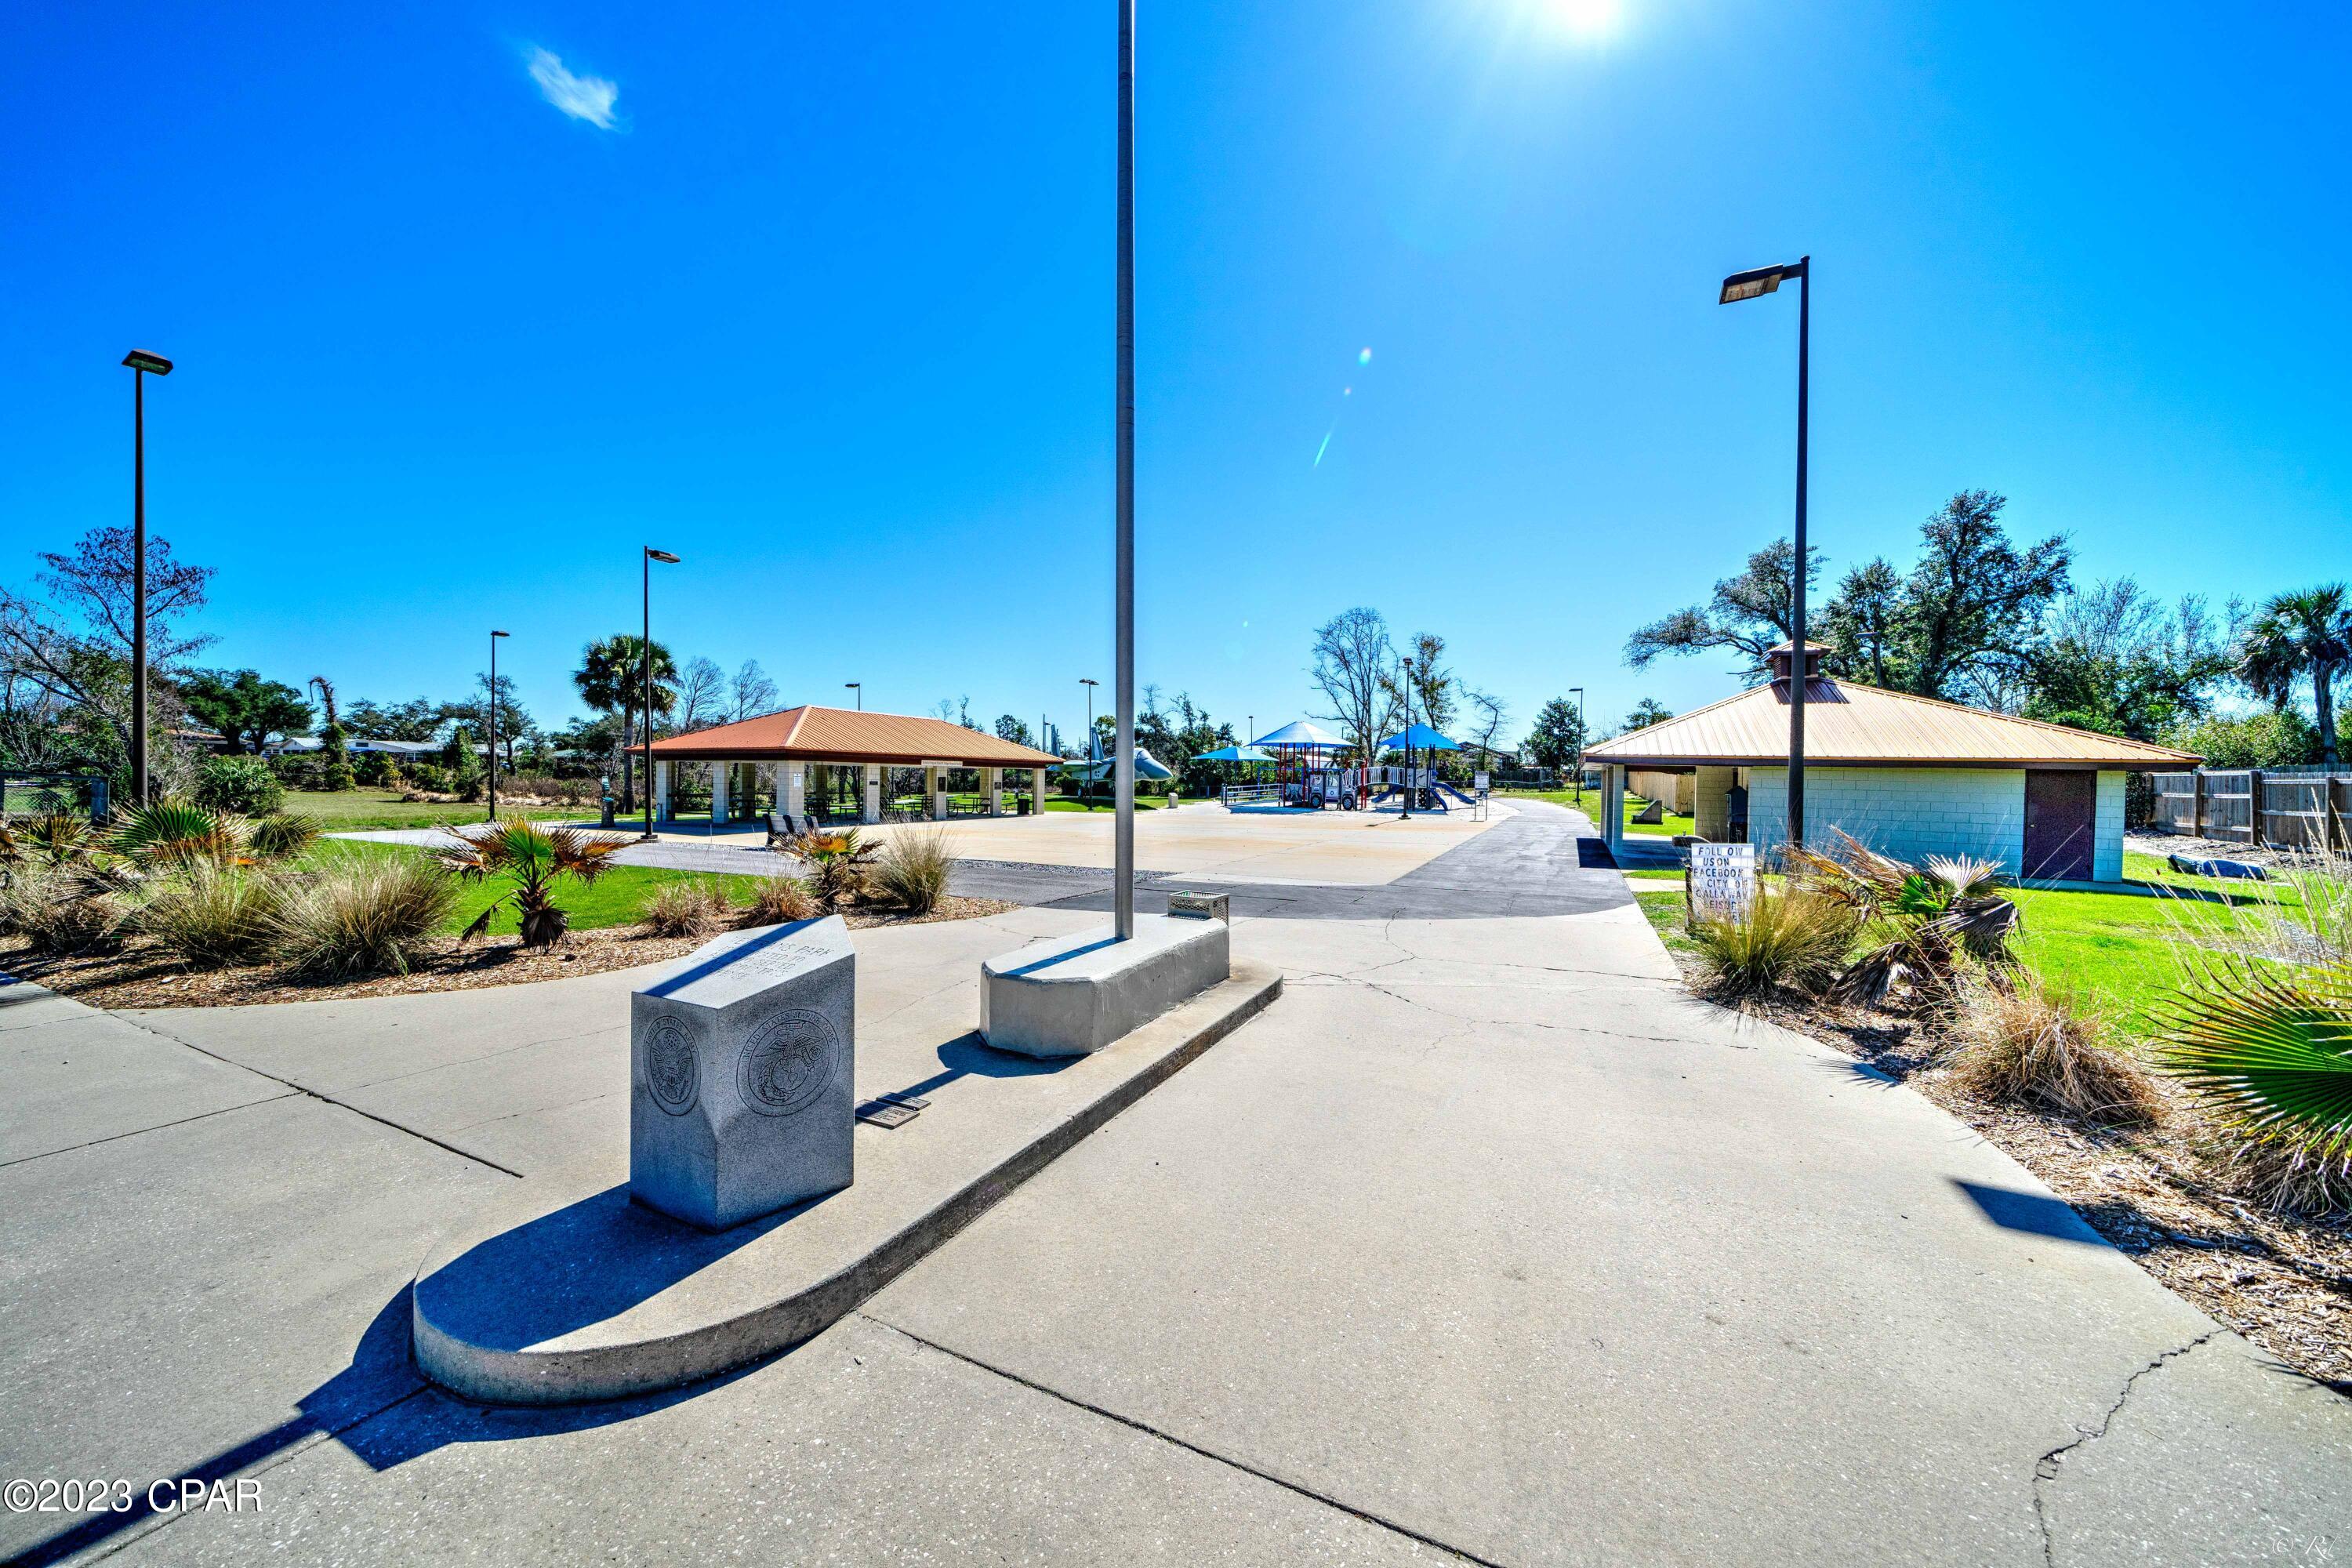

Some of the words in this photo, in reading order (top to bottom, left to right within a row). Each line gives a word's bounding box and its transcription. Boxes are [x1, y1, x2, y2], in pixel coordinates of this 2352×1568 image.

[1693, 868, 1744, 877] FACEBOOK
[1707, 879, 1728, 887] CITY
[796, 945, 834, 956] PARK
[645, 1022, 661, 1047] UNITED
[663, 1018, 683, 1032] STATES
[742, 1034, 760, 1062] UNITED
[761, 1012, 789, 1031] STATES
[793, 1011, 820, 1025] MARINE
